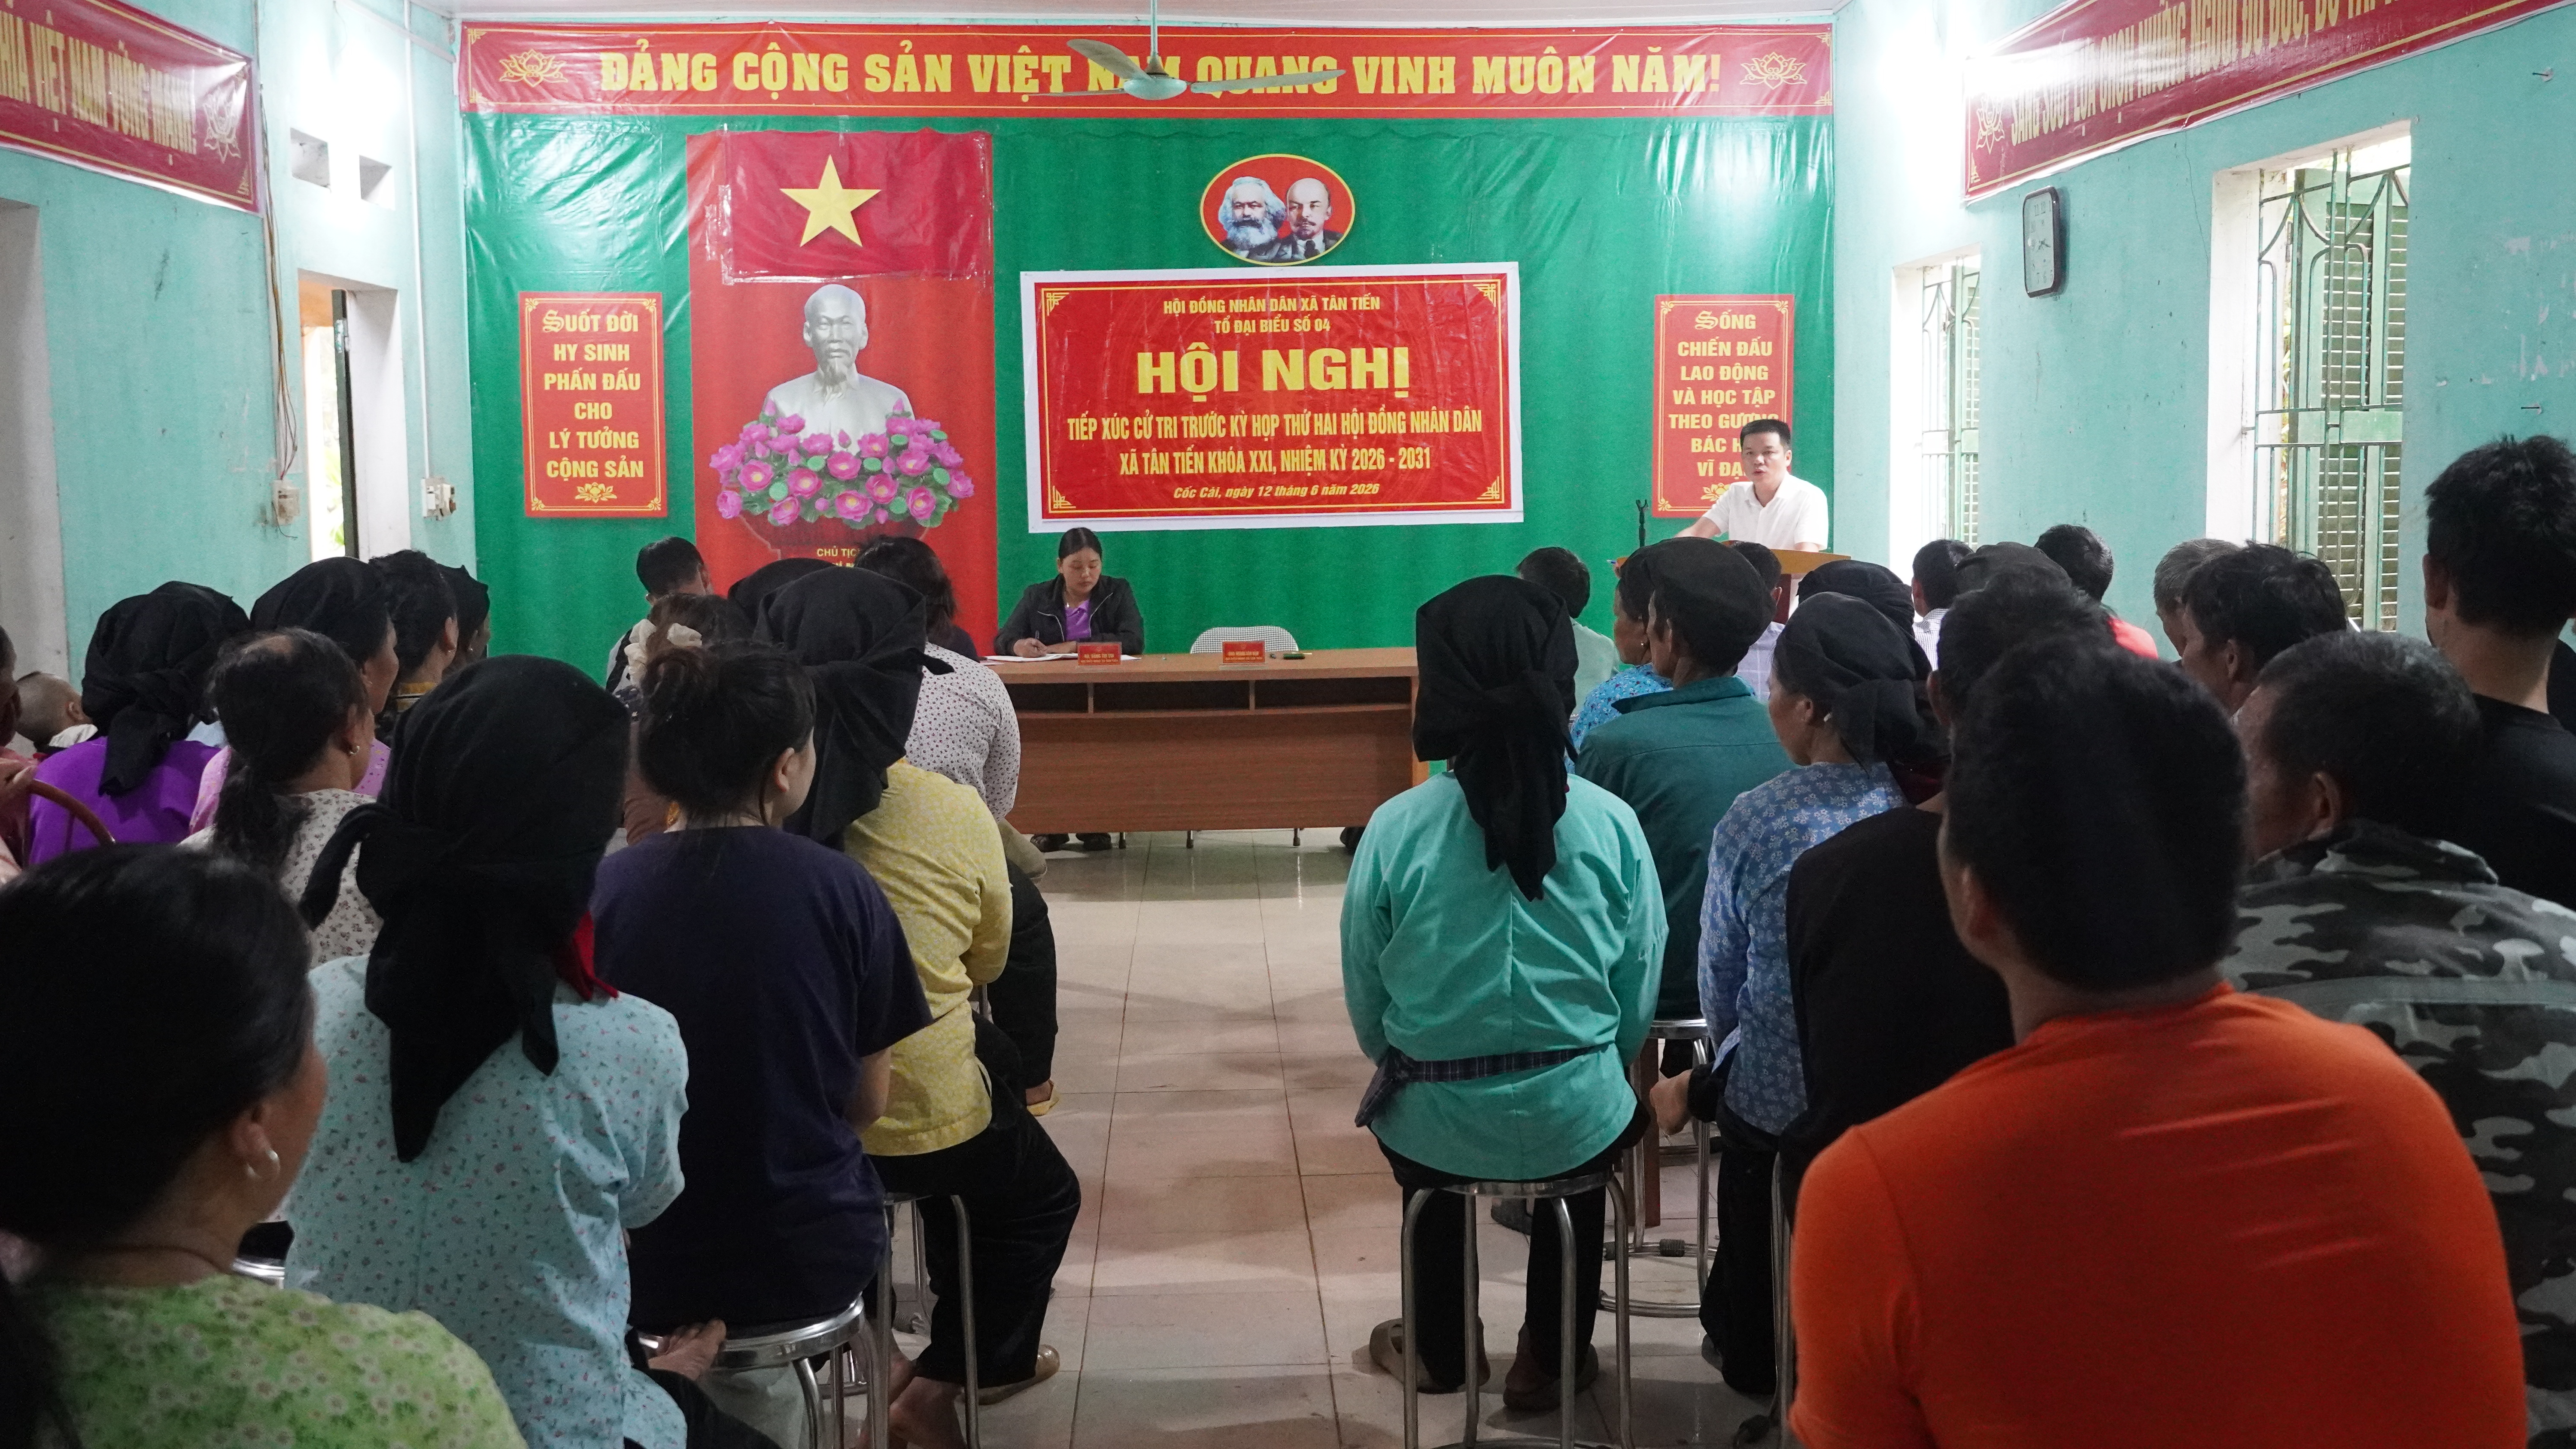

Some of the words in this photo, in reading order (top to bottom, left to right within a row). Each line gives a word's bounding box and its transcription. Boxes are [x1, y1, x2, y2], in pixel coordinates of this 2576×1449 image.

[601, 39, 717, 92] ĐẢNG
[732, 42, 848, 100] CỘNG
[865, 40, 952, 92] SẢN
[968, 45, 1071, 102] VIỆT
[1197, 56, 1337, 99] QUANG
[1352, 56, 1455, 94] VINH
[1472, 46, 1596, 94] MUÔN
[1612, 46, 1720, 92] NĂM!
[1164, 298, 1185, 316] HỘI
[1189, 296, 1225, 313] ĐỒNG
[1230, 297, 1266, 312] NHÂN
[1270, 296, 1297, 311] DÂN
[1301, 296, 1318, 311] XÃ
[1322, 296, 1347, 310] TÂN
[1352, 293, 1380, 310] TIẾN
[542, 309, 601, 333] SUỐT
[607, 311, 638, 332] ĐỜI
[1215, 315, 1230, 333] TỔ
[1234, 320, 1256, 336] ĐẠI
[1260, 314, 1289, 333] BIỂU
[1294, 314, 1311, 332] SỐ
[1315, 318, 1331, 331] 04
[1695, 309, 1756, 330] SỐNG
[554, 344, 578, 361] HY
[584, 344, 630, 361] SINH
[1677, 336, 1731, 357] CHIẾN
[1736, 336, 1772, 356] ĐẤU
[544, 367, 596, 390] PHẤN
[602, 367, 640, 390] ĐẤU
[1138, 342, 1238, 402] HỘI
[1262, 347, 1409, 398] NGHỊ
[1680, 366, 1714, 380] LAO
[1719, 363, 1768, 383] ĐỘNG
[1673, 387, 1695, 404] VÀ
[1701, 390, 1737, 408] HỌC
[1742, 387, 1775, 408] TẬP
[574, 402, 612, 419] CHO
[1068, 411, 1097, 440] TIẾP
[1102, 413, 1129, 440] XÚC
[1134, 409, 1153, 439] CỬ
[1156, 415, 1177, 439] TRI
[1181, 411, 1226, 438] TRƯỚC
[1230, 410, 1248, 437] KỲ
[1252, 414, 1280, 441] HỌP
[1284, 409, 1311, 436] THỨ
[1314, 413, 1337, 435] HAI
[1341, 408, 1364, 439] HỘI
[1368, 405, 1406, 434] ĐỒNG
[1410, 406, 1449, 433] NHÂN
[1453, 406, 1482, 432] DÂN
[1668, 414, 1712, 429] THEO
[550, 428, 571, 449] LÝ
[577, 426, 639, 449] TƯỞNG
[1691, 435, 1726, 452] BÁC
[547, 457, 598, 481] CỘNG
[605, 455, 643, 477] SẢN
[1120, 449, 1139, 475] XÃ
[1142, 448, 1169, 474] TÂN
[1173, 444, 1204, 474] TIẾN
[1208, 446, 1245, 473] KHÓA
[1249, 450, 1276, 475] XXI,
[1281, 445, 1326, 476] NHIỆM
[1330, 444, 1347, 470] KỲ
[1352, 448, 1385, 470] 2026
[1399, 447, 1431, 469] 2031
[1697, 459, 1714, 476] VĨ
[1174, 486, 1197, 498] Cốc
[1200, 486, 1221, 499] Cái,
[1225, 486, 1255, 498] ngày
[1258, 486, 1271, 497] 12
[1275, 485, 1308, 497] tháng
[1311, 485, 1318, 495] 6
[1321, 484, 1347, 495] năm
[1350, 484, 1380, 494] 2026
[817, 546, 838, 557] CHỦ
[841, 548, 860, 558] TỊC
